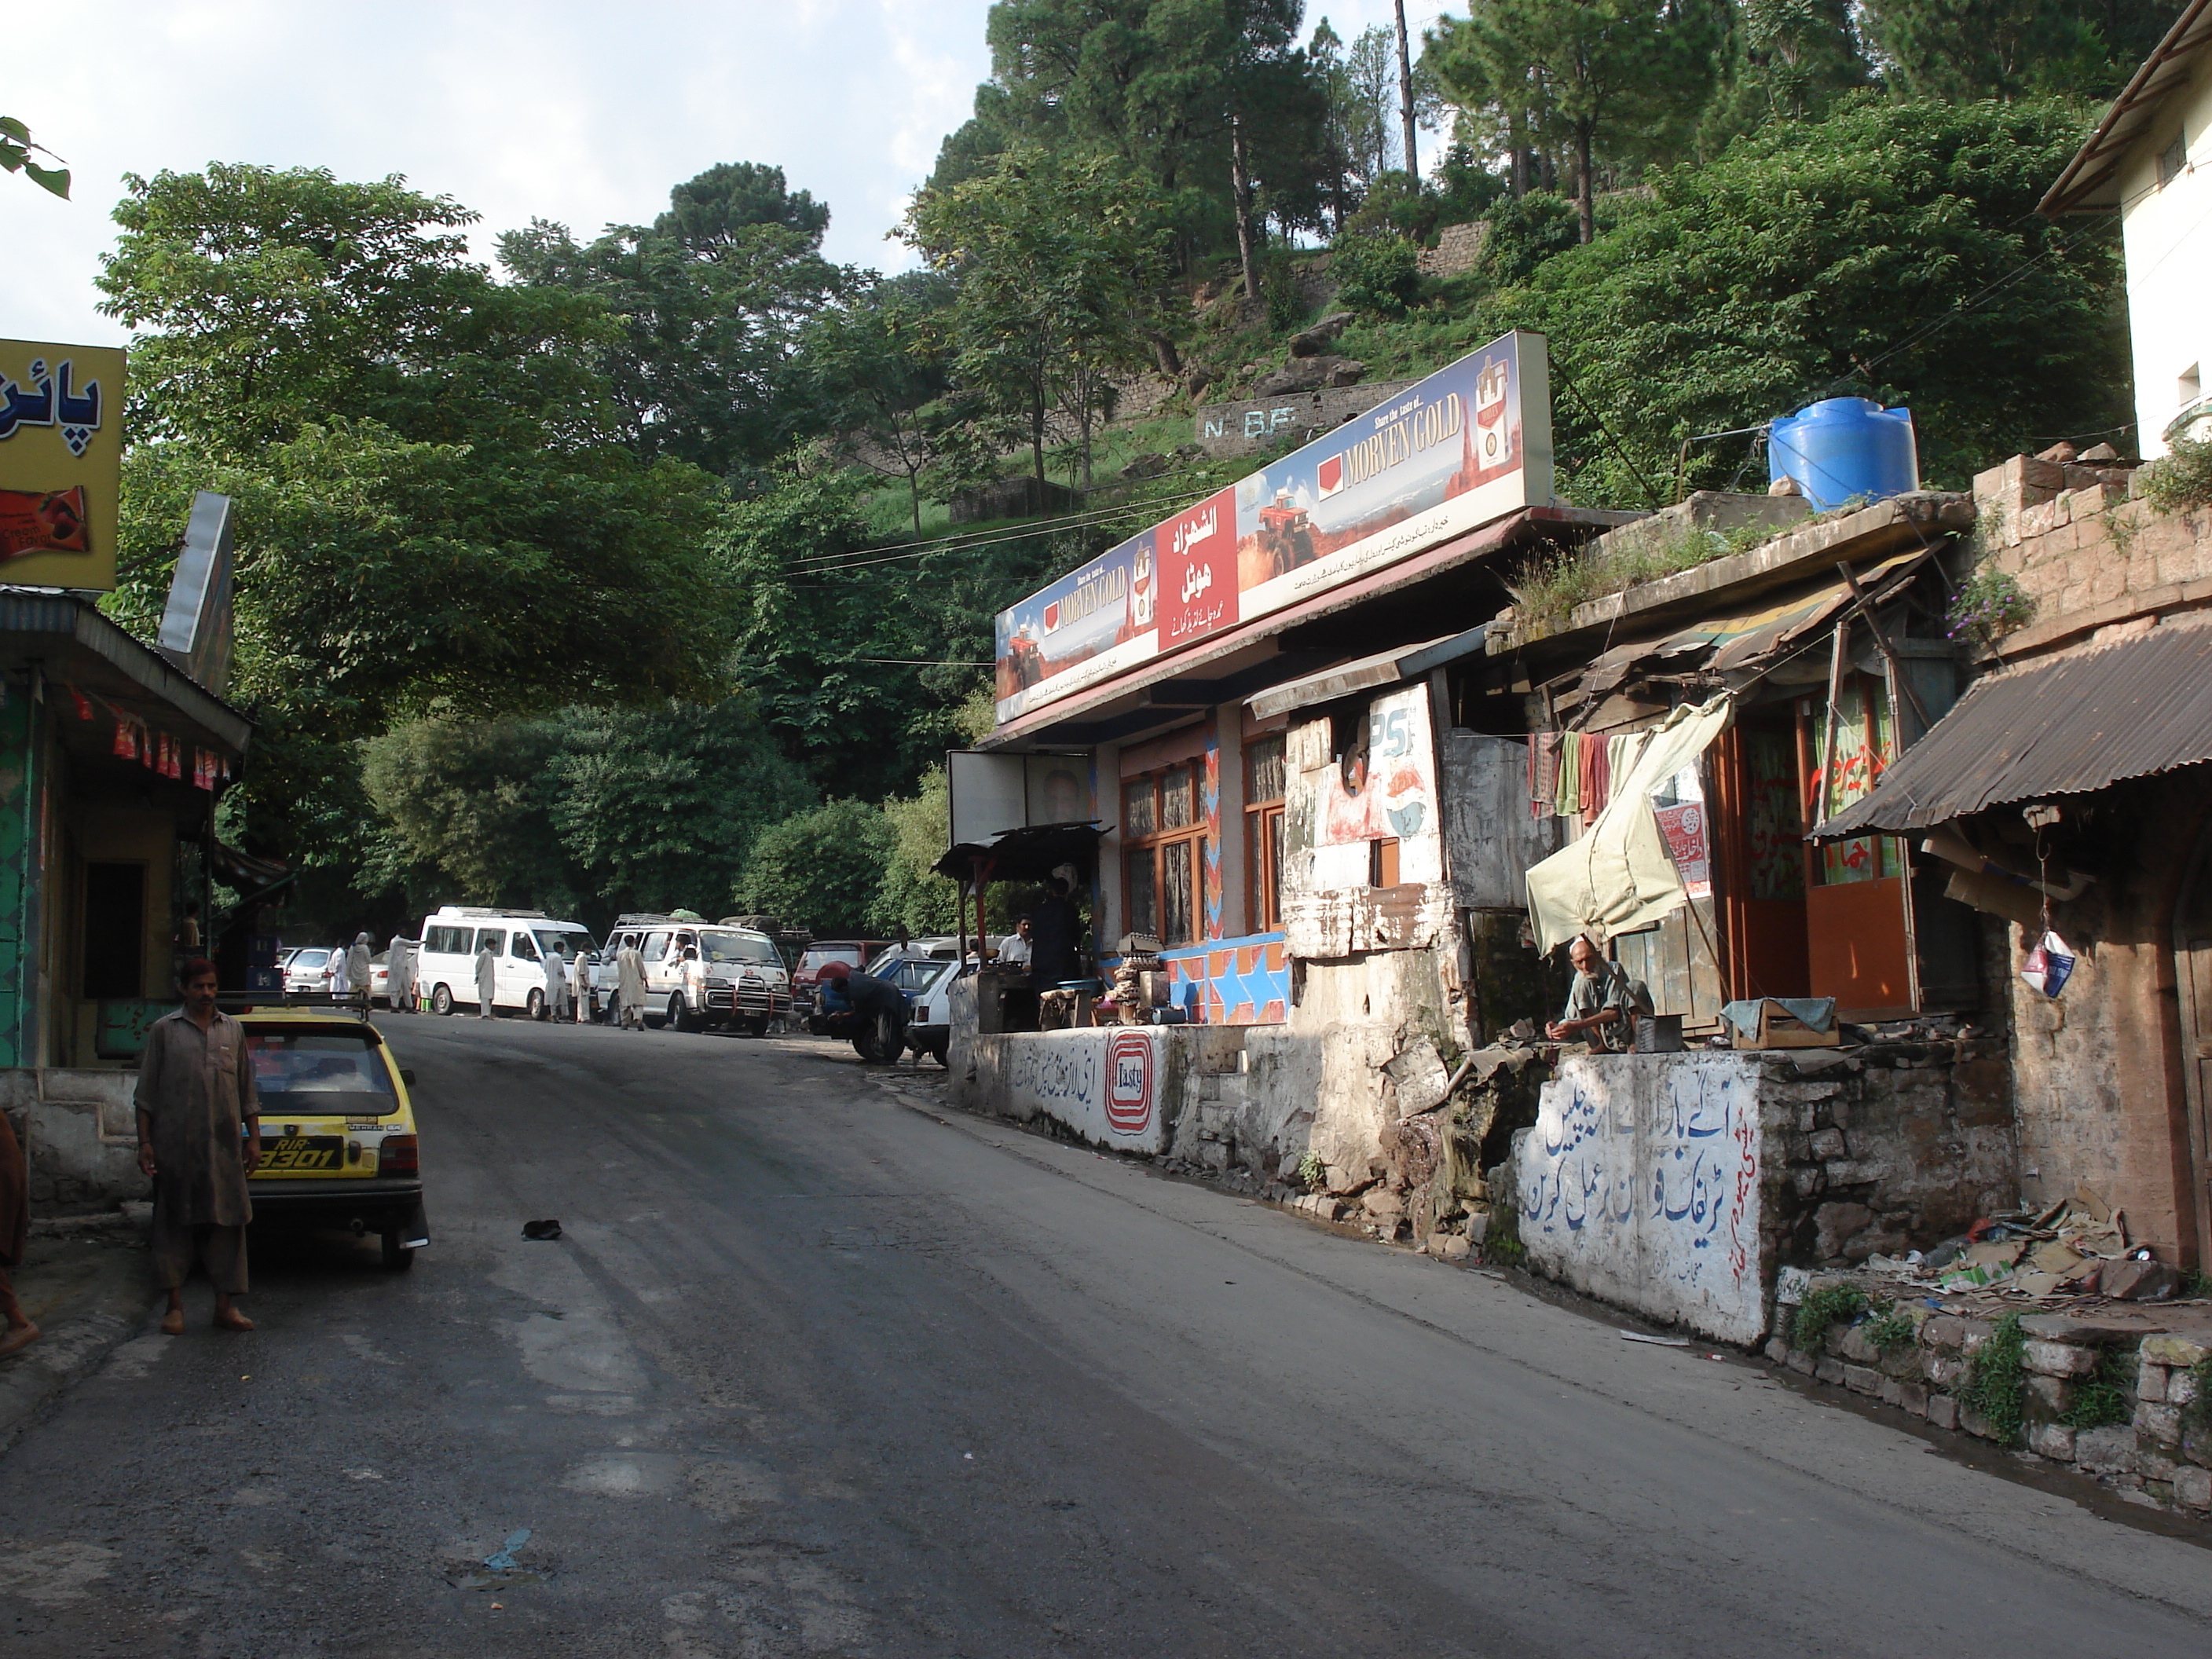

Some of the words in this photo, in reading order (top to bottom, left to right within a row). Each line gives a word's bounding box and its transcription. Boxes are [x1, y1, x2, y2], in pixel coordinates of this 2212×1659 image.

[1346, 417, 1411, 489] MORVEN
[1414, 393, 1460, 452] GOLD
[1060, 580, 1097, 628] MORVEN
[1100, 566, 1126, 607] GOLD
[1119, 1062, 1142, 1093] Tasty
[273, 1139, 309, 1150] RIR
